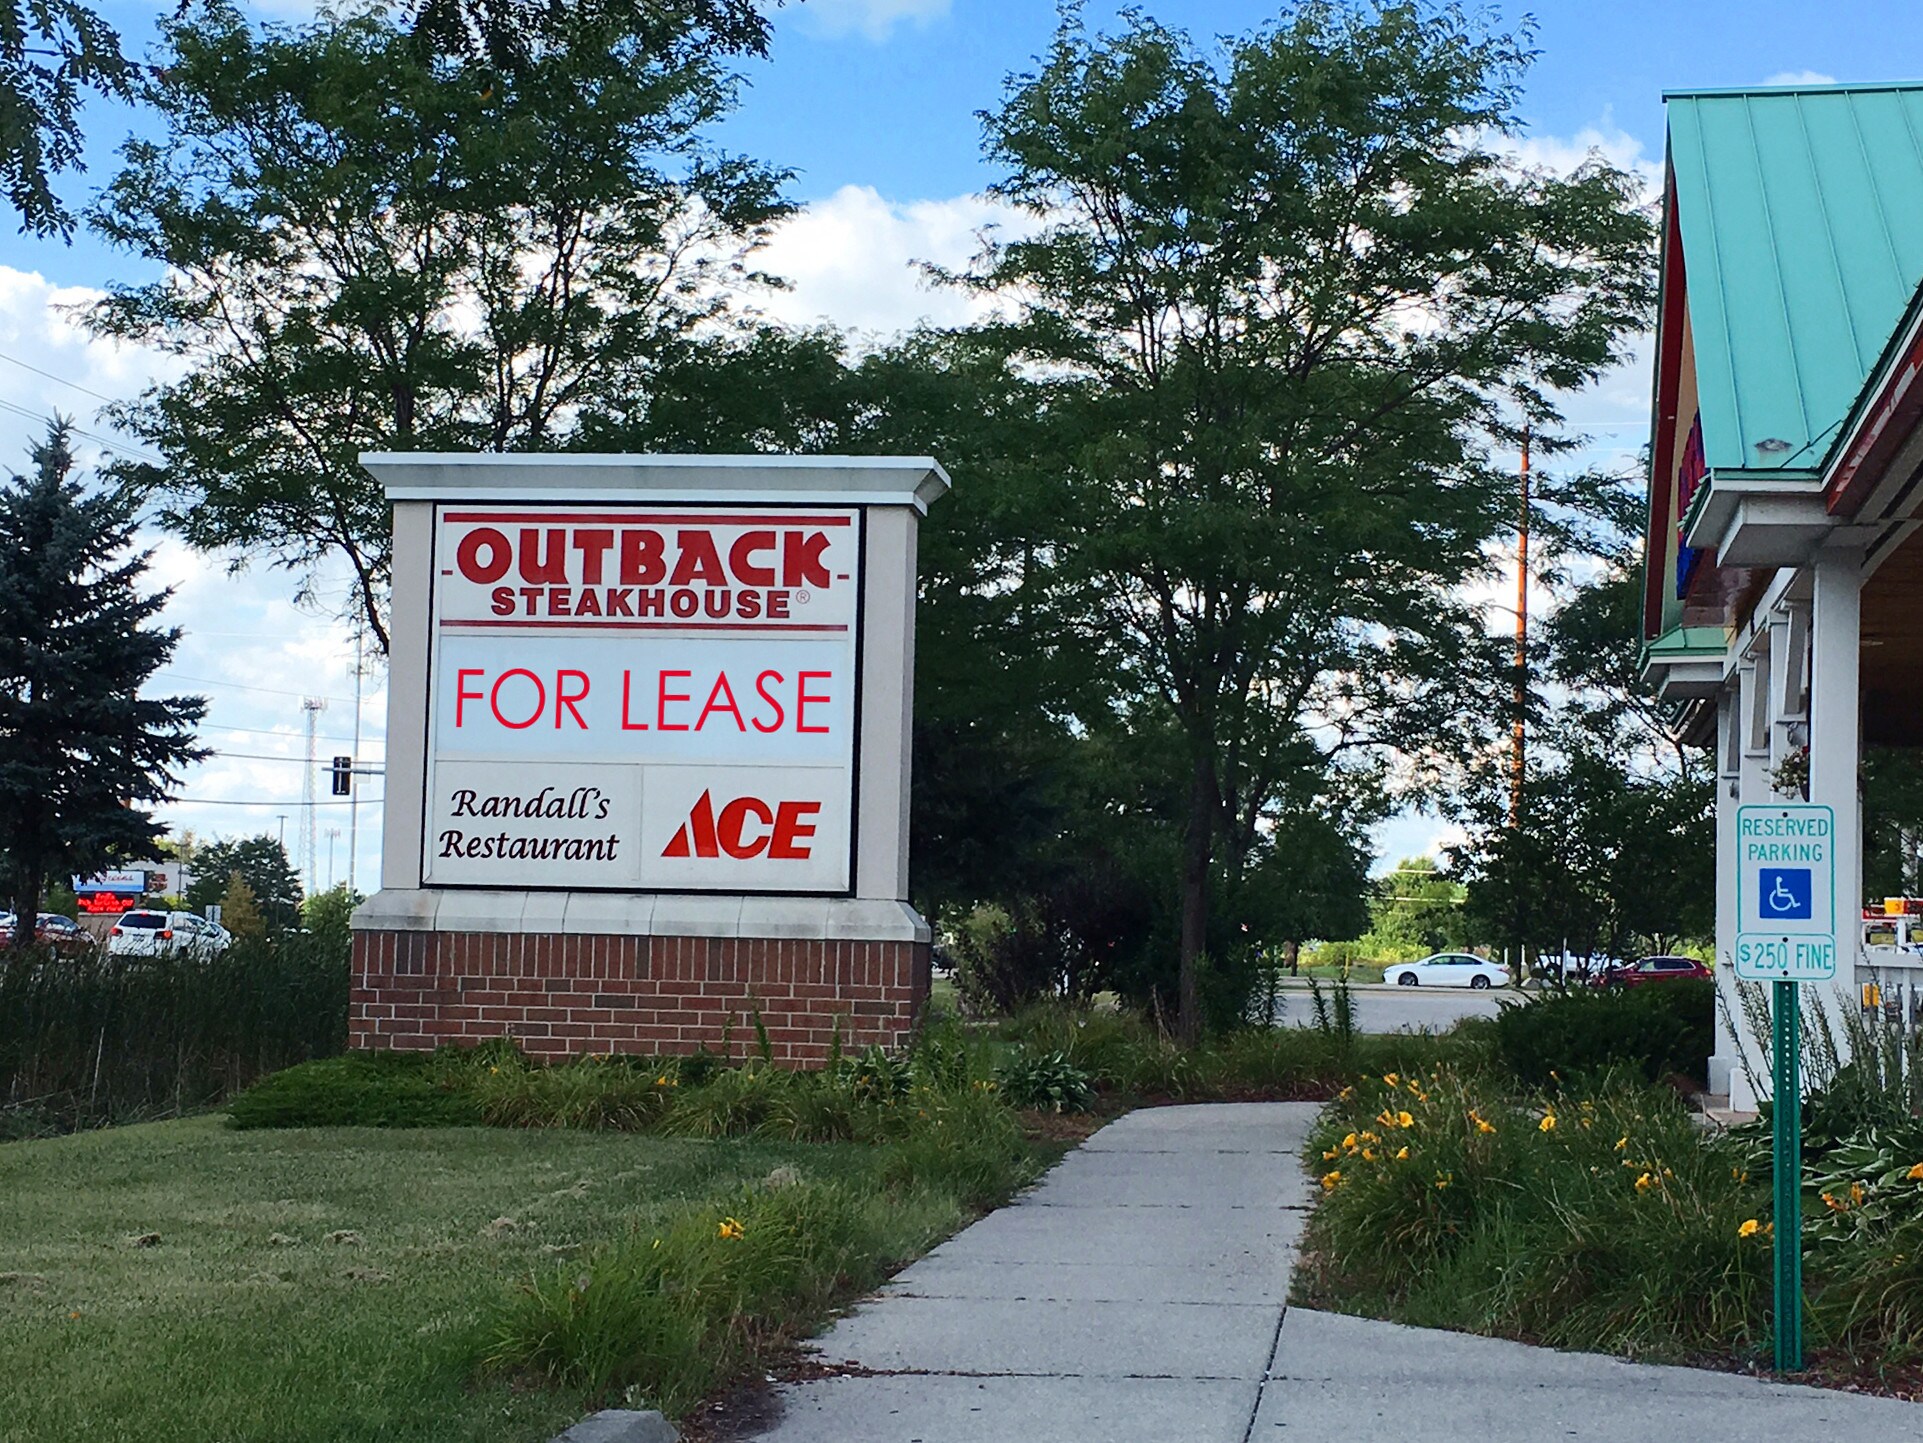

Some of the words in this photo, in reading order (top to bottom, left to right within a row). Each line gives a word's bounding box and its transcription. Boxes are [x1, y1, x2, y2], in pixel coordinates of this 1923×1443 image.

[457, 527, 831, 589] OUTBACK
[491, 586, 790, 619] STEAKHOUSE
[455, 667, 590, 731] FOR
[621, 669, 833, 734] LEASE
[450, 786, 611, 820] Randall's
[661, 788, 821, 860] ACE
[1742, 818, 1829, 837] RESERVED
[438, 829, 620, 862] Restaurant
[1748, 844, 1823, 862] PARKING
[1796, 943, 1833, 970] FINE
